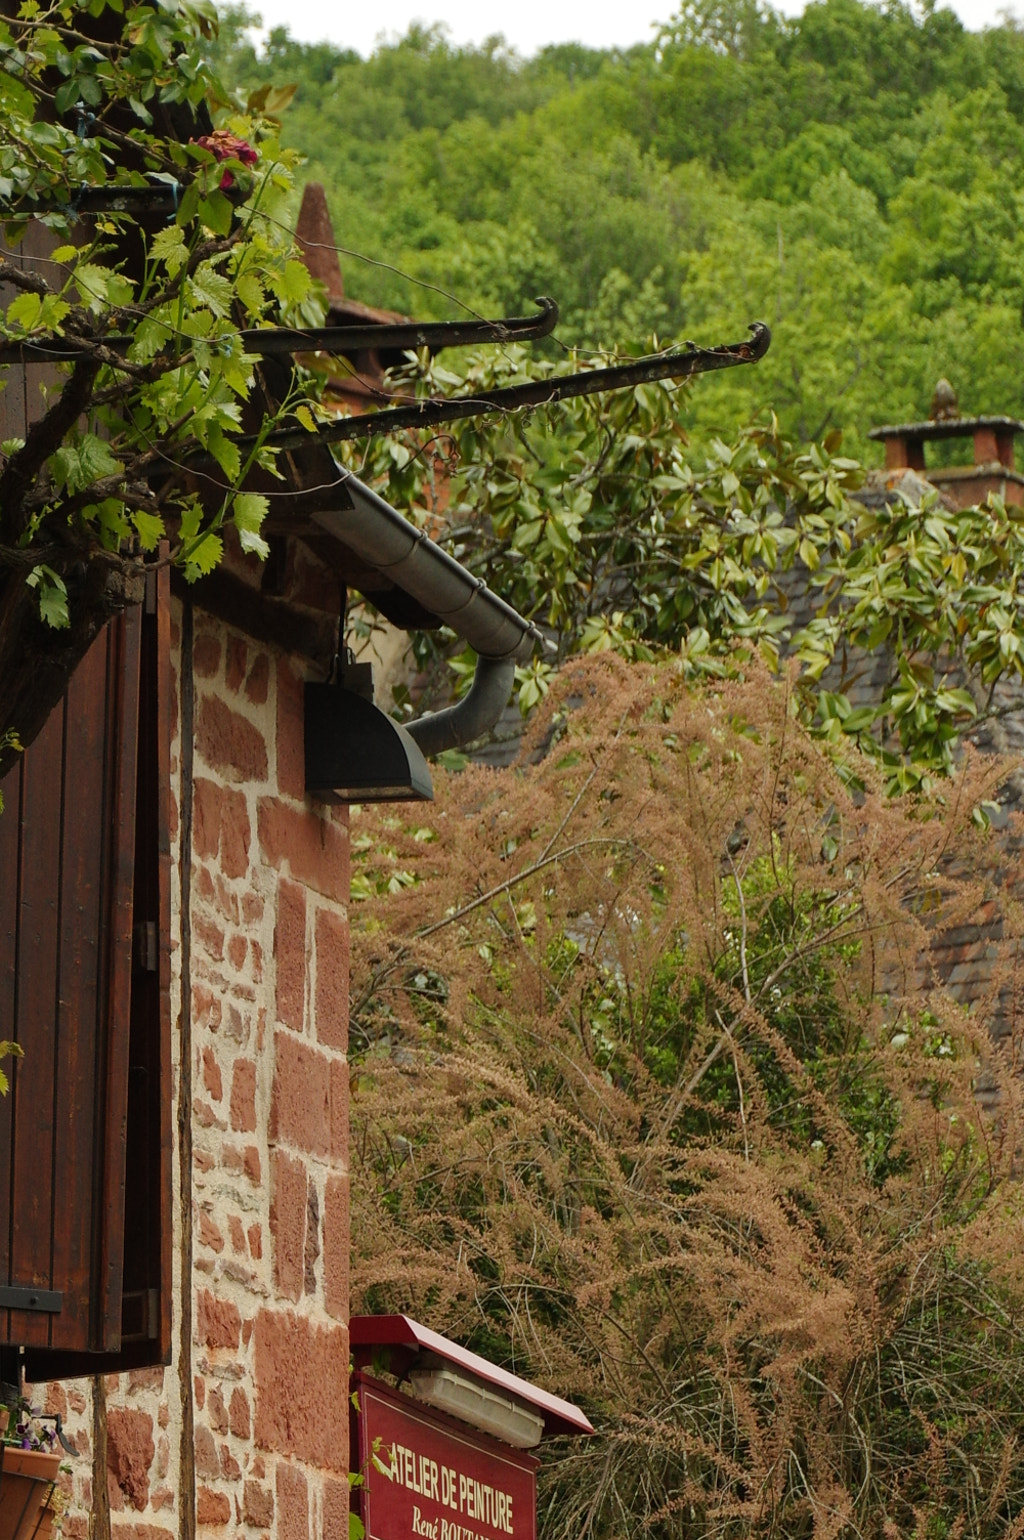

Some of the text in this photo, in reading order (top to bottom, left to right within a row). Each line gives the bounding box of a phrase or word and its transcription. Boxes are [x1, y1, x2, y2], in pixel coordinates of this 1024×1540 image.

[373, 1442, 514, 1535] ATELIER DE PEINTURE
